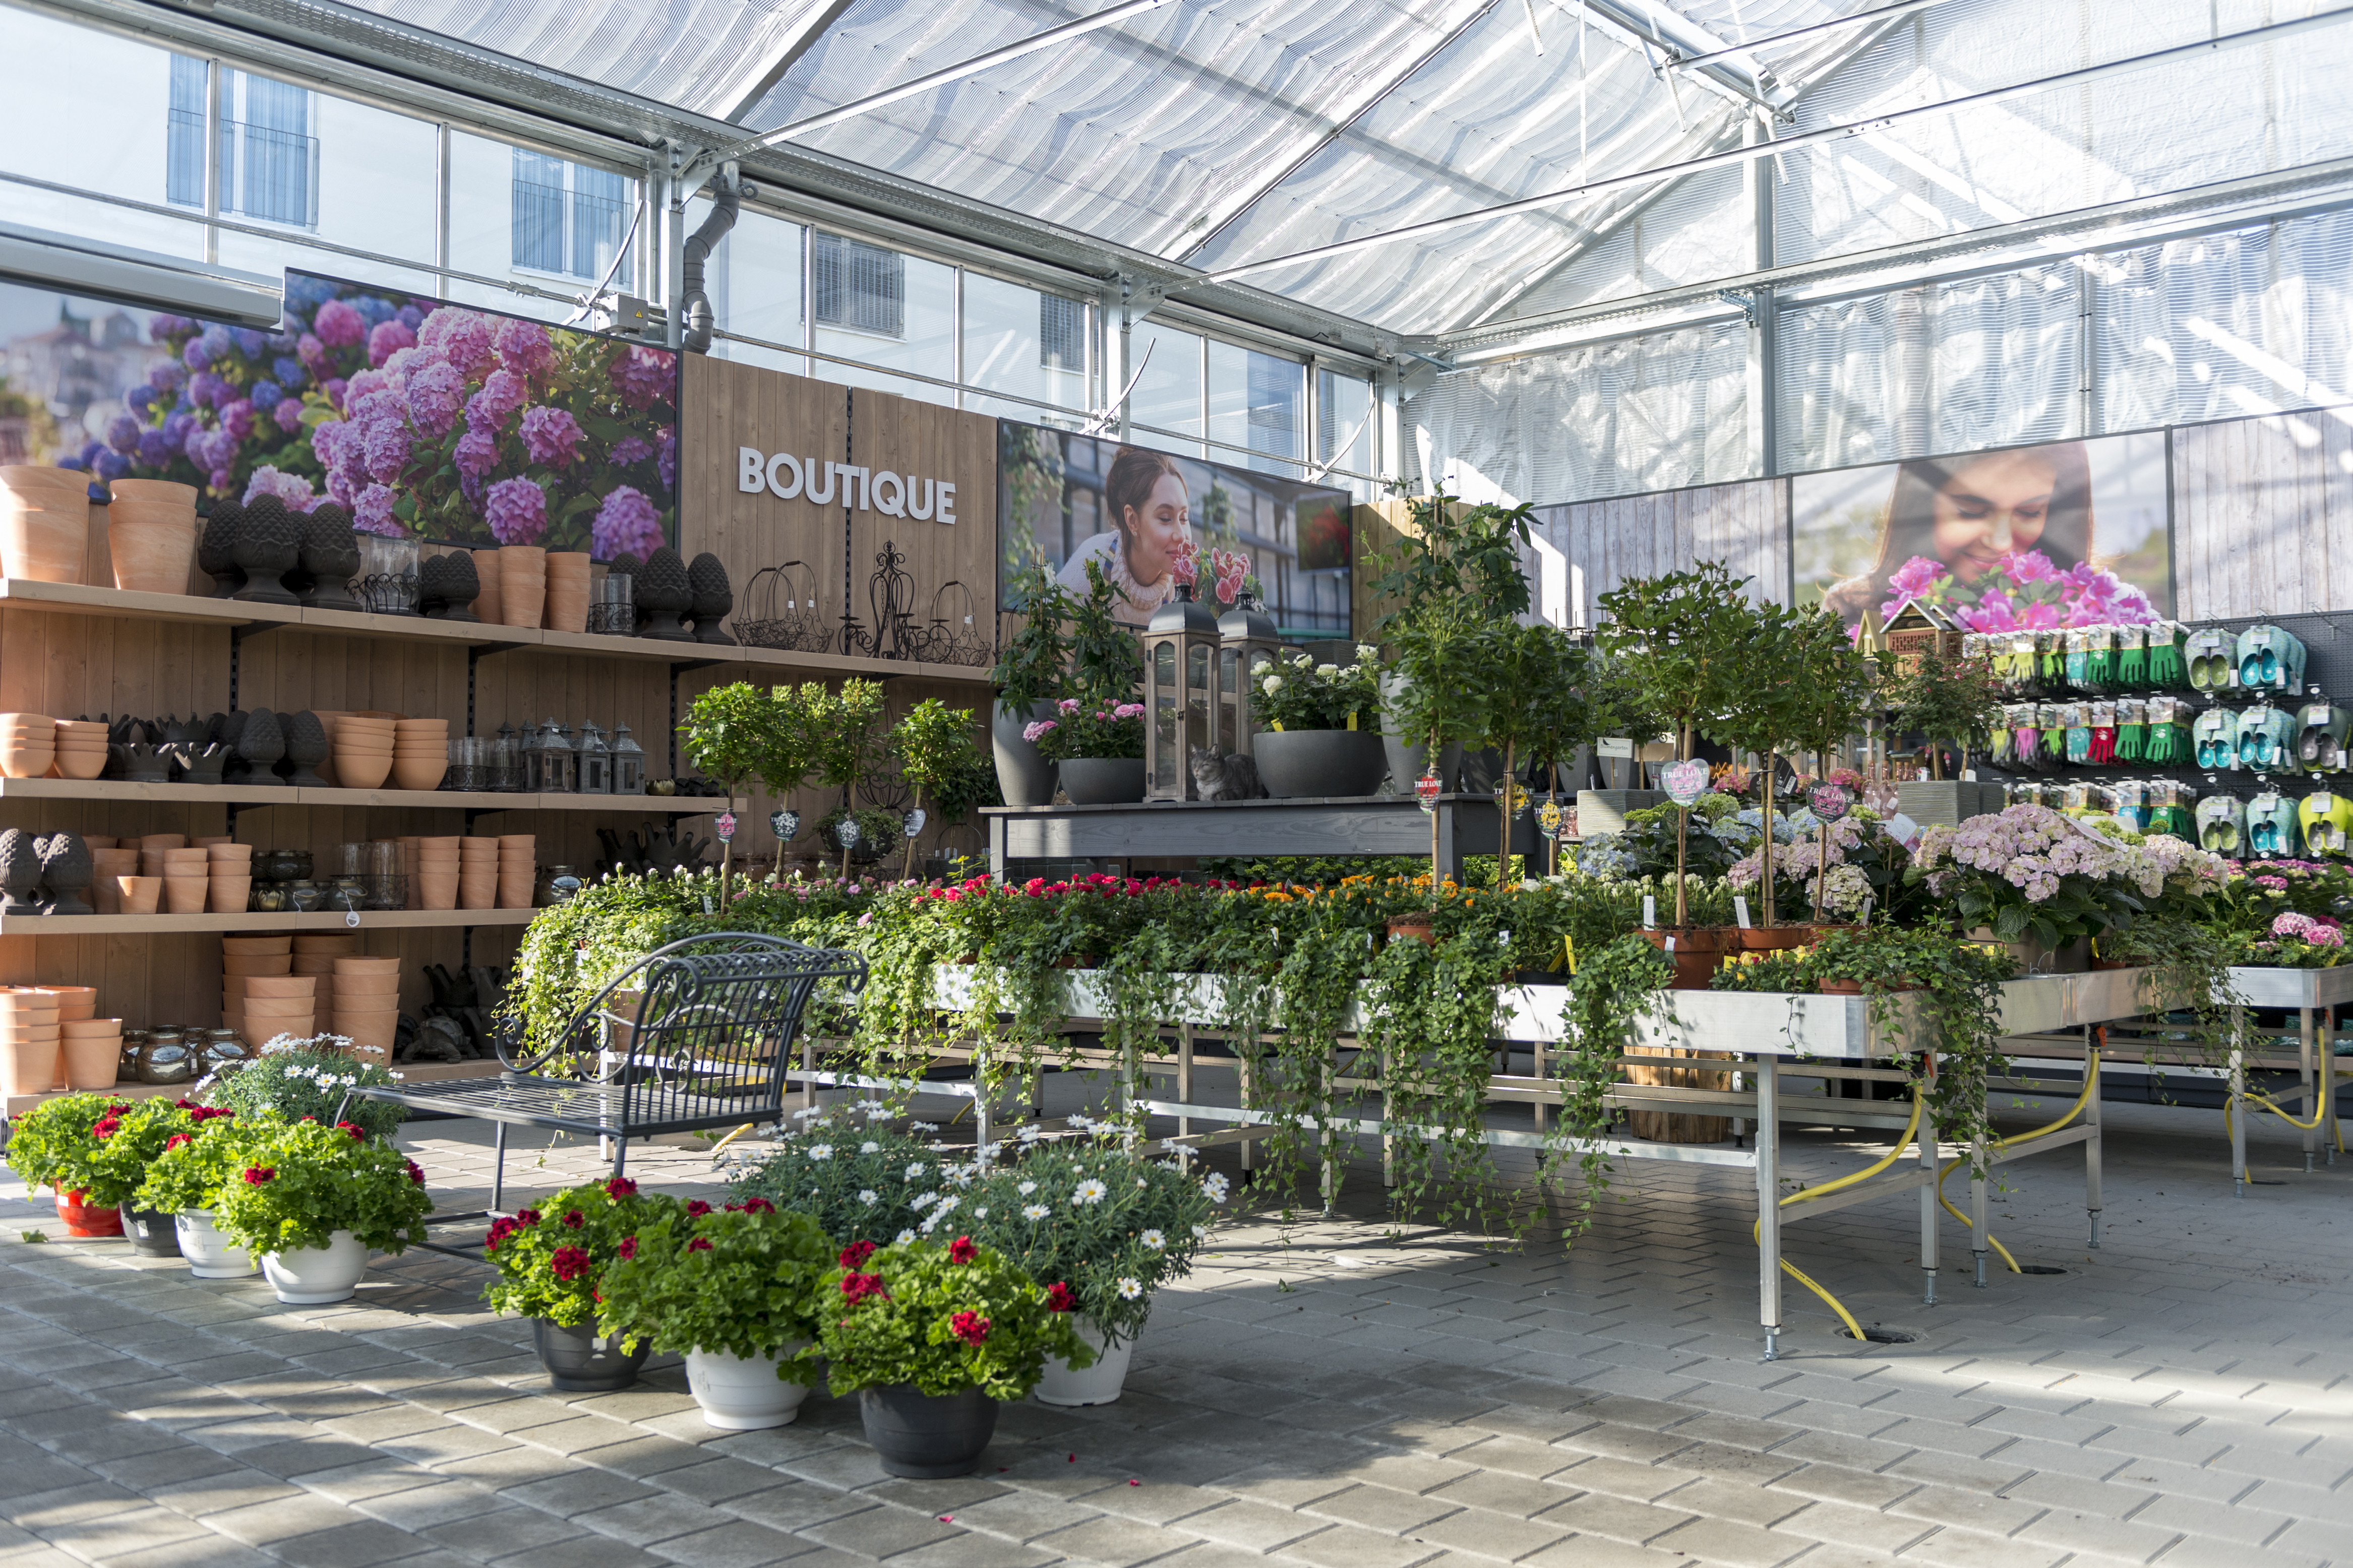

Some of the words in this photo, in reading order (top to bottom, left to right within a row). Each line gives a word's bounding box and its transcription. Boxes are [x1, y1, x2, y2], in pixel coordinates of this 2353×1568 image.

[739, 446, 956, 525] BOUTIQUE
[1662, 770, 1684, 779] TRUE
[1686, 768, 1708, 776] LOVE
[1808, 786, 1830, 797] TRUE
[1831, 792, 1853, 803] LOVE
